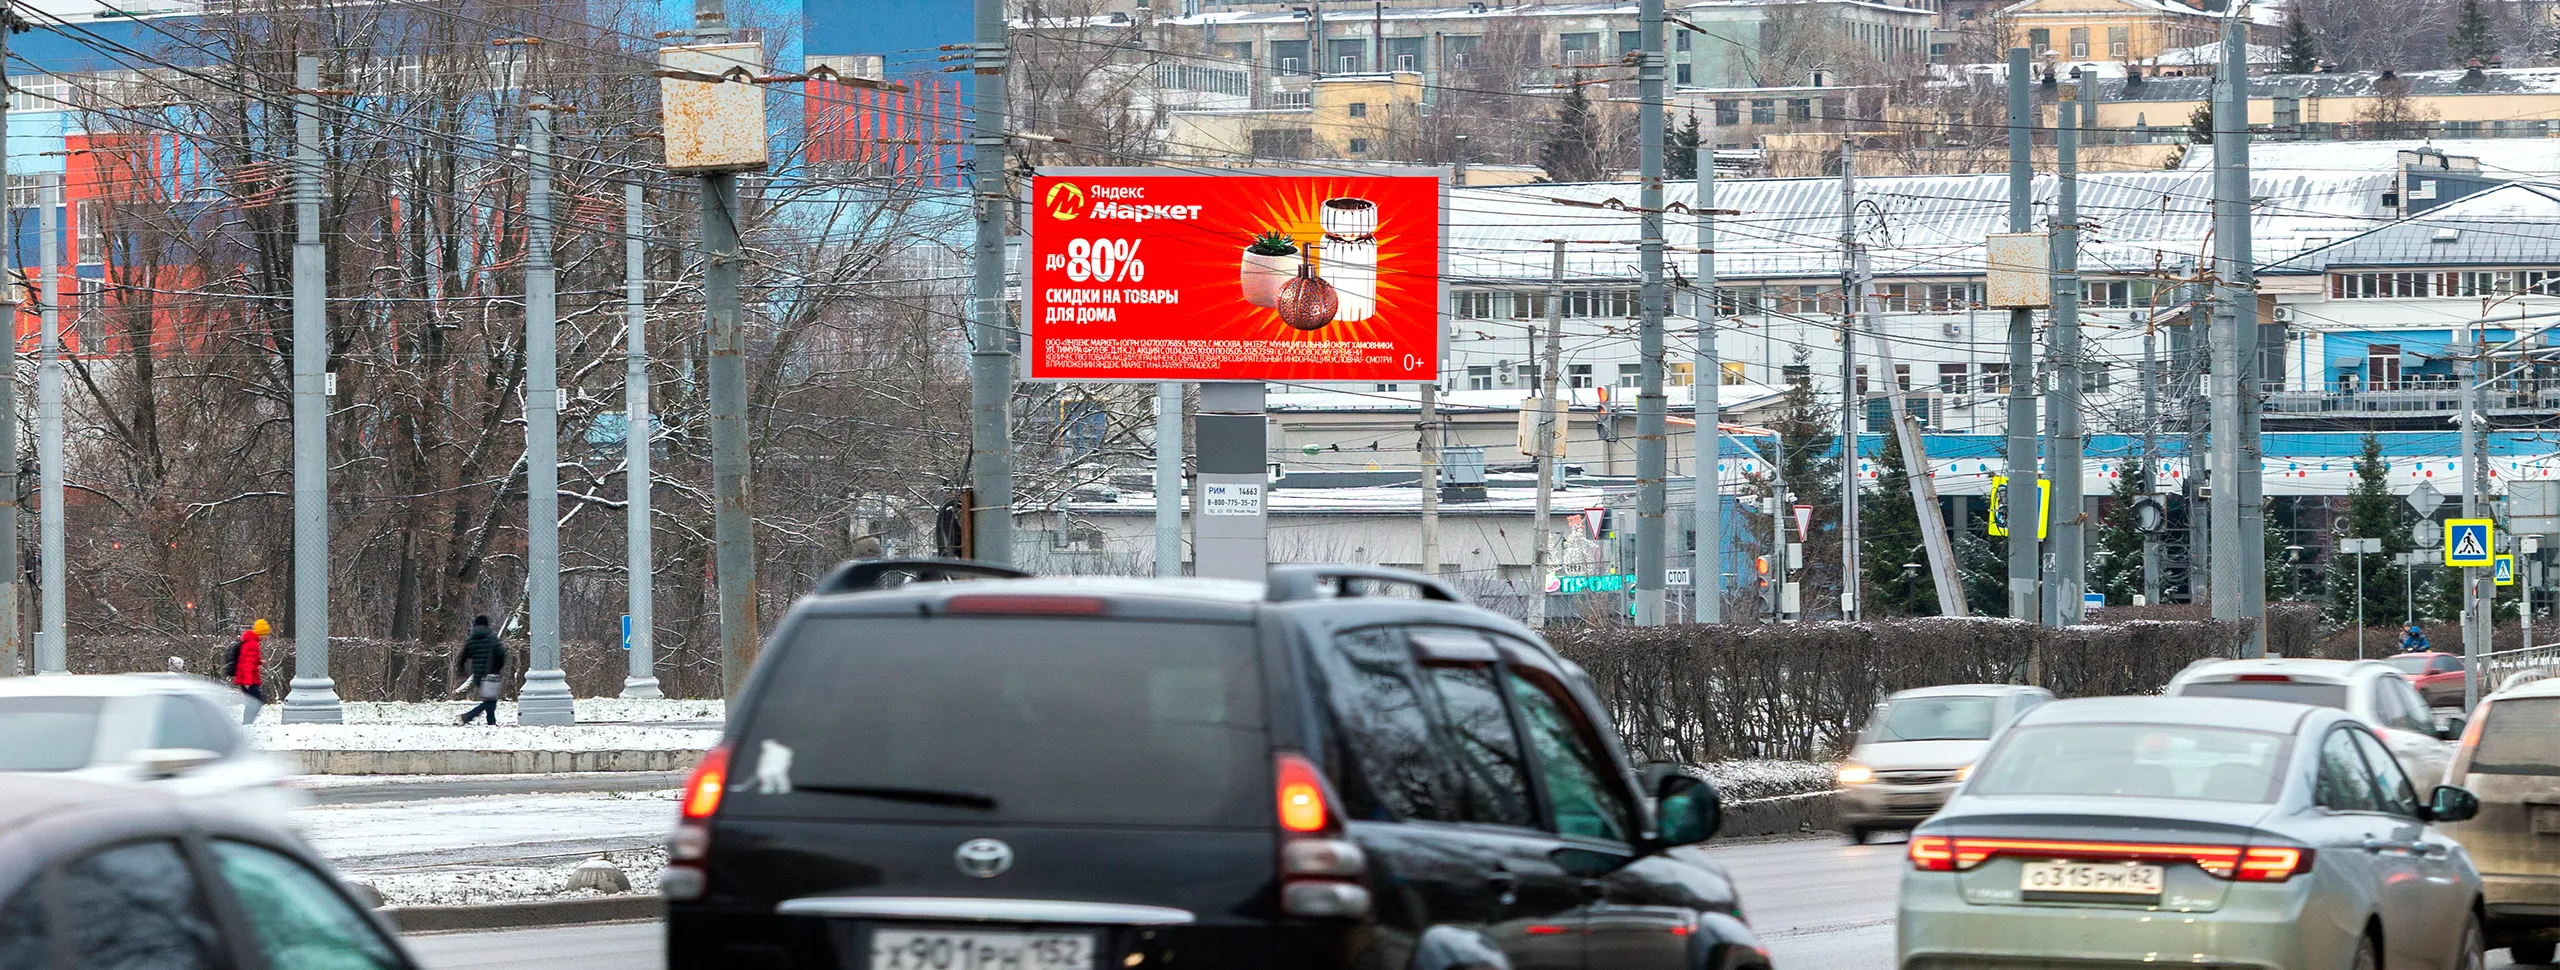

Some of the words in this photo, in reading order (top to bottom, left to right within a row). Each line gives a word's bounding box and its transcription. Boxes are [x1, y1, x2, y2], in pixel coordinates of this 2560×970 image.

[1091, 185, 1144, 200] Яндекс
[1090, 201, 1203, 222] Маркет
[1067, 238, 1145, 282] 80%
[1046, 288, 1100, 306] СКИДКИ
[1103, 289, 1121, 304] НА
[1124, 289, 1178, 304] ТОВАРЫ
[1046, 307, 1074, 325] ДЛЯ
[1077, 307, 1117, 325] ДОМА
[1366, 356, 1392, 364] СМОТРИ
[1403, 353, 1425, 372] 0+
[1668, 571, 1687, 583] СТОП
